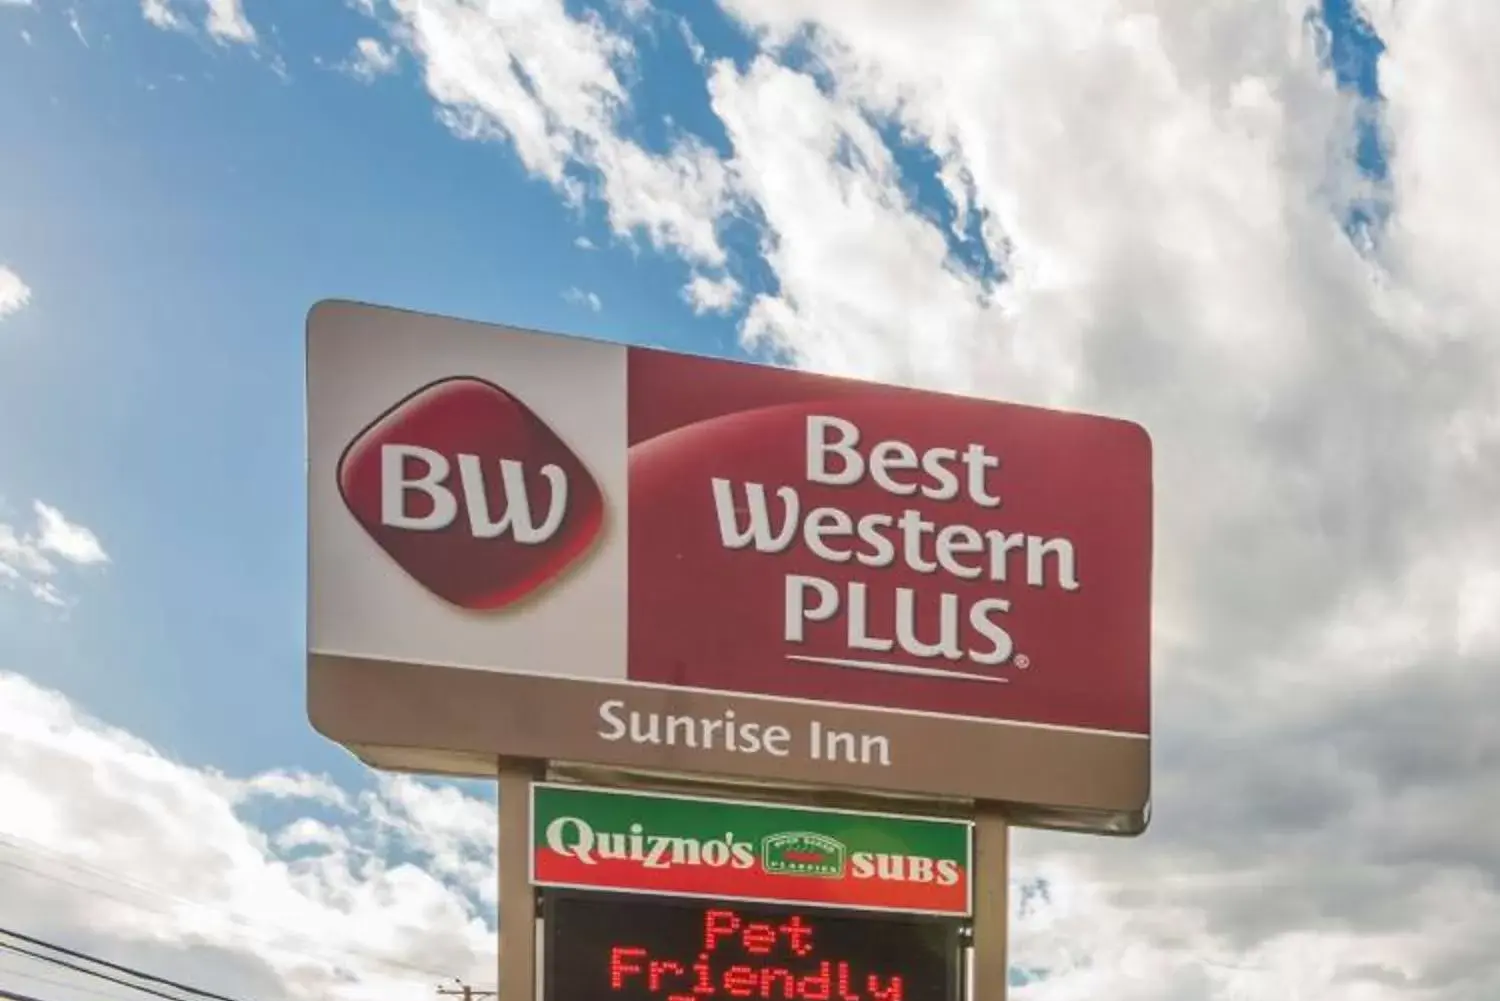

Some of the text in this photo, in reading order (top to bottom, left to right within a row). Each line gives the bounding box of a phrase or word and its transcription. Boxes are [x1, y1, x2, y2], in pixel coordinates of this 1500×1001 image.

[382, 444, 567, 544] BW
[806, 415, 1001, 507] Best
[711, 477, 1080, 590] Western
[598, 700, 891, 765] Sunrise Inn
[546, 816, 755, 869] Quizno's
[852, 852, 958, 886] SUBS
[705, 909, 812, 955] Pet
